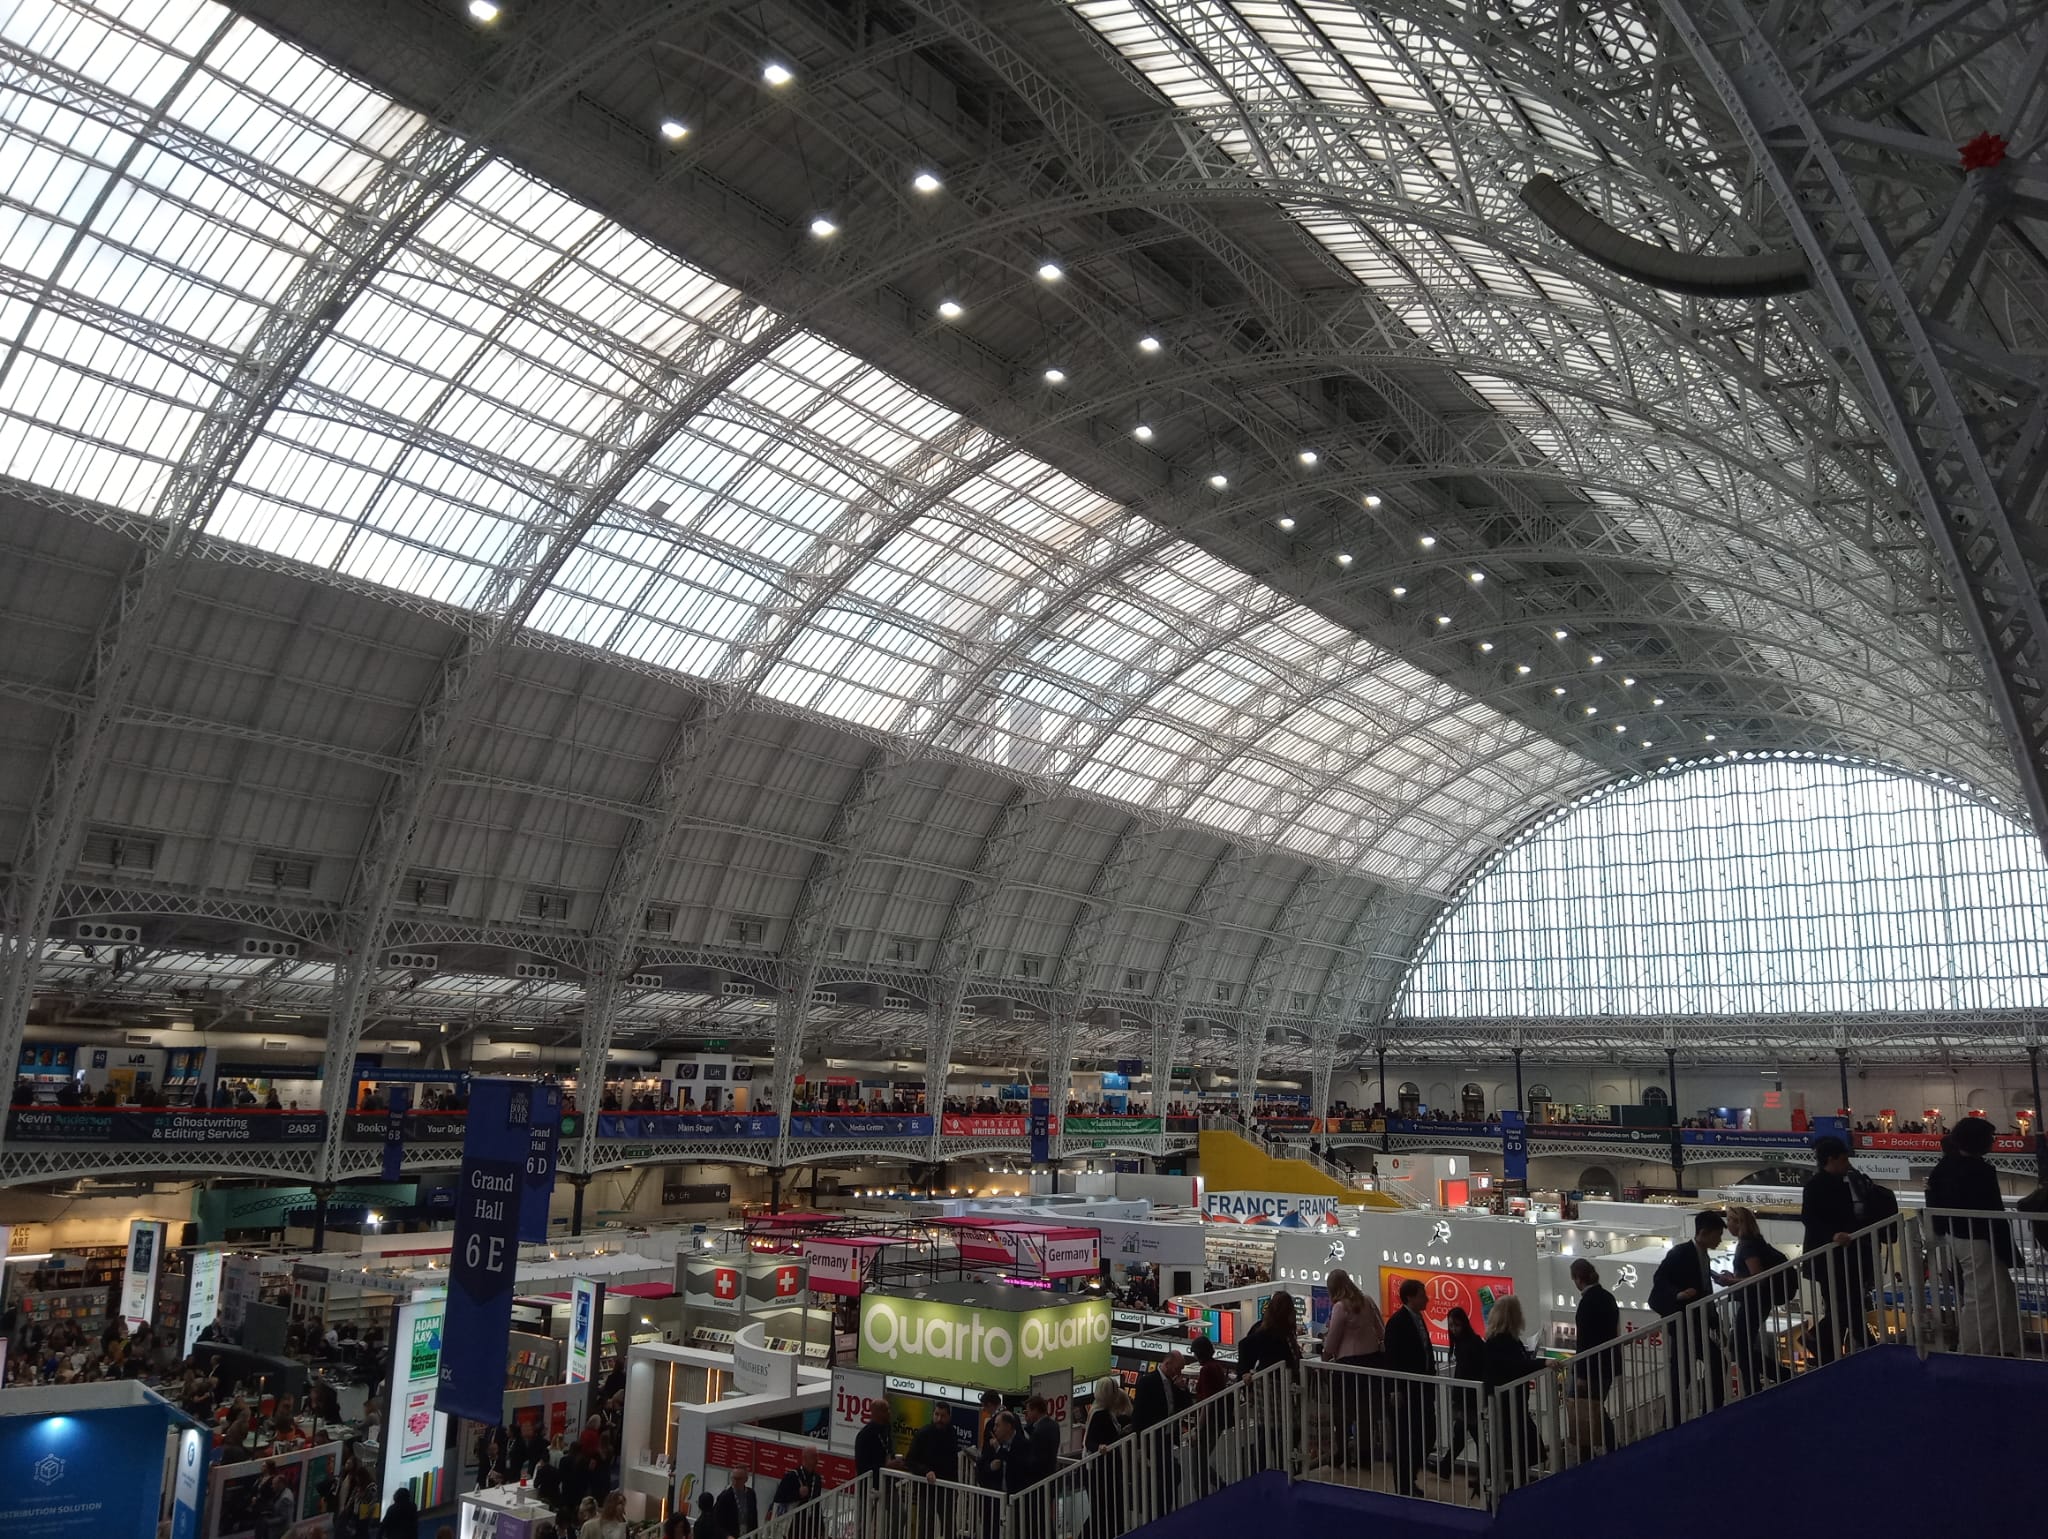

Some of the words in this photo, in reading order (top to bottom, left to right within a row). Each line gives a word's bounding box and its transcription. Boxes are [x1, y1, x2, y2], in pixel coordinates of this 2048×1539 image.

[711, 1068, 721, 1076] Lift
[18, 1112, 52, 1123] Kevin
[56, 1114, 112, 1125] Anderson
[173, 1116, 248, 1130] Ghostwriting
[288, 1124, 316, 1134] 2A93
[427, 1124, 446, 1133] Your
[678, 1123, 694, 1132] Main
[695, 1123, 713, 1133] Stage
[152, 1129, 162, 1139] &
[164, 1129, 205, 1141] Editing
[207, 1129, 249, 1139] Service
[531, 1141, 546, 1150] Hall
[1890, 1137, 1919, 1146] Books
[1998, 1139, 2024, 1148] 2C10
[1866, 1164, 1900, 1174] Schuster
[471, 1169, 514, 1192] Grand
[1779, 1171, 1801, 1185] Exit
[680, 1191, 689, 1199] Lift
[1717, 1193, 1744, 1204] Simon
[1747, 1195, 1754, 1203] &
[1756, 1195, 1793, 1205] Schuster
[474, 1198, 504, 1221] Hall
[1207, 1194, 1289, 1218] FRANCE
[1299, 1197, 1338, 1216] FRANCE
[11, 1237, 29, 1247] ART
[805, 1249, 848, 1272] Germany
[1048, 1247, 1090, 1263] Germany
[1383, 1250, 1507, 1271] BLOOMSBURY
[1434, 1279, 1459, 1301] 10
[1120, 1313, 1140, 1322] Quarto
[416, 1317, 440, 1331] ADAM
[414, 1330, 433, 1343] KAY
[864, 1303, 1013, 1367] Quarto
[1021, 1307, 1110, 1359] Quarto
[1140, 1341, 1163, 1350] Quarto
[892, 1378, 915, 1390] Quarto
[939, 1386, 946, 1396] Q
[836, 1386, 873, 1424] ipg
[58, 1502, 103, 1514] SOLUTION
